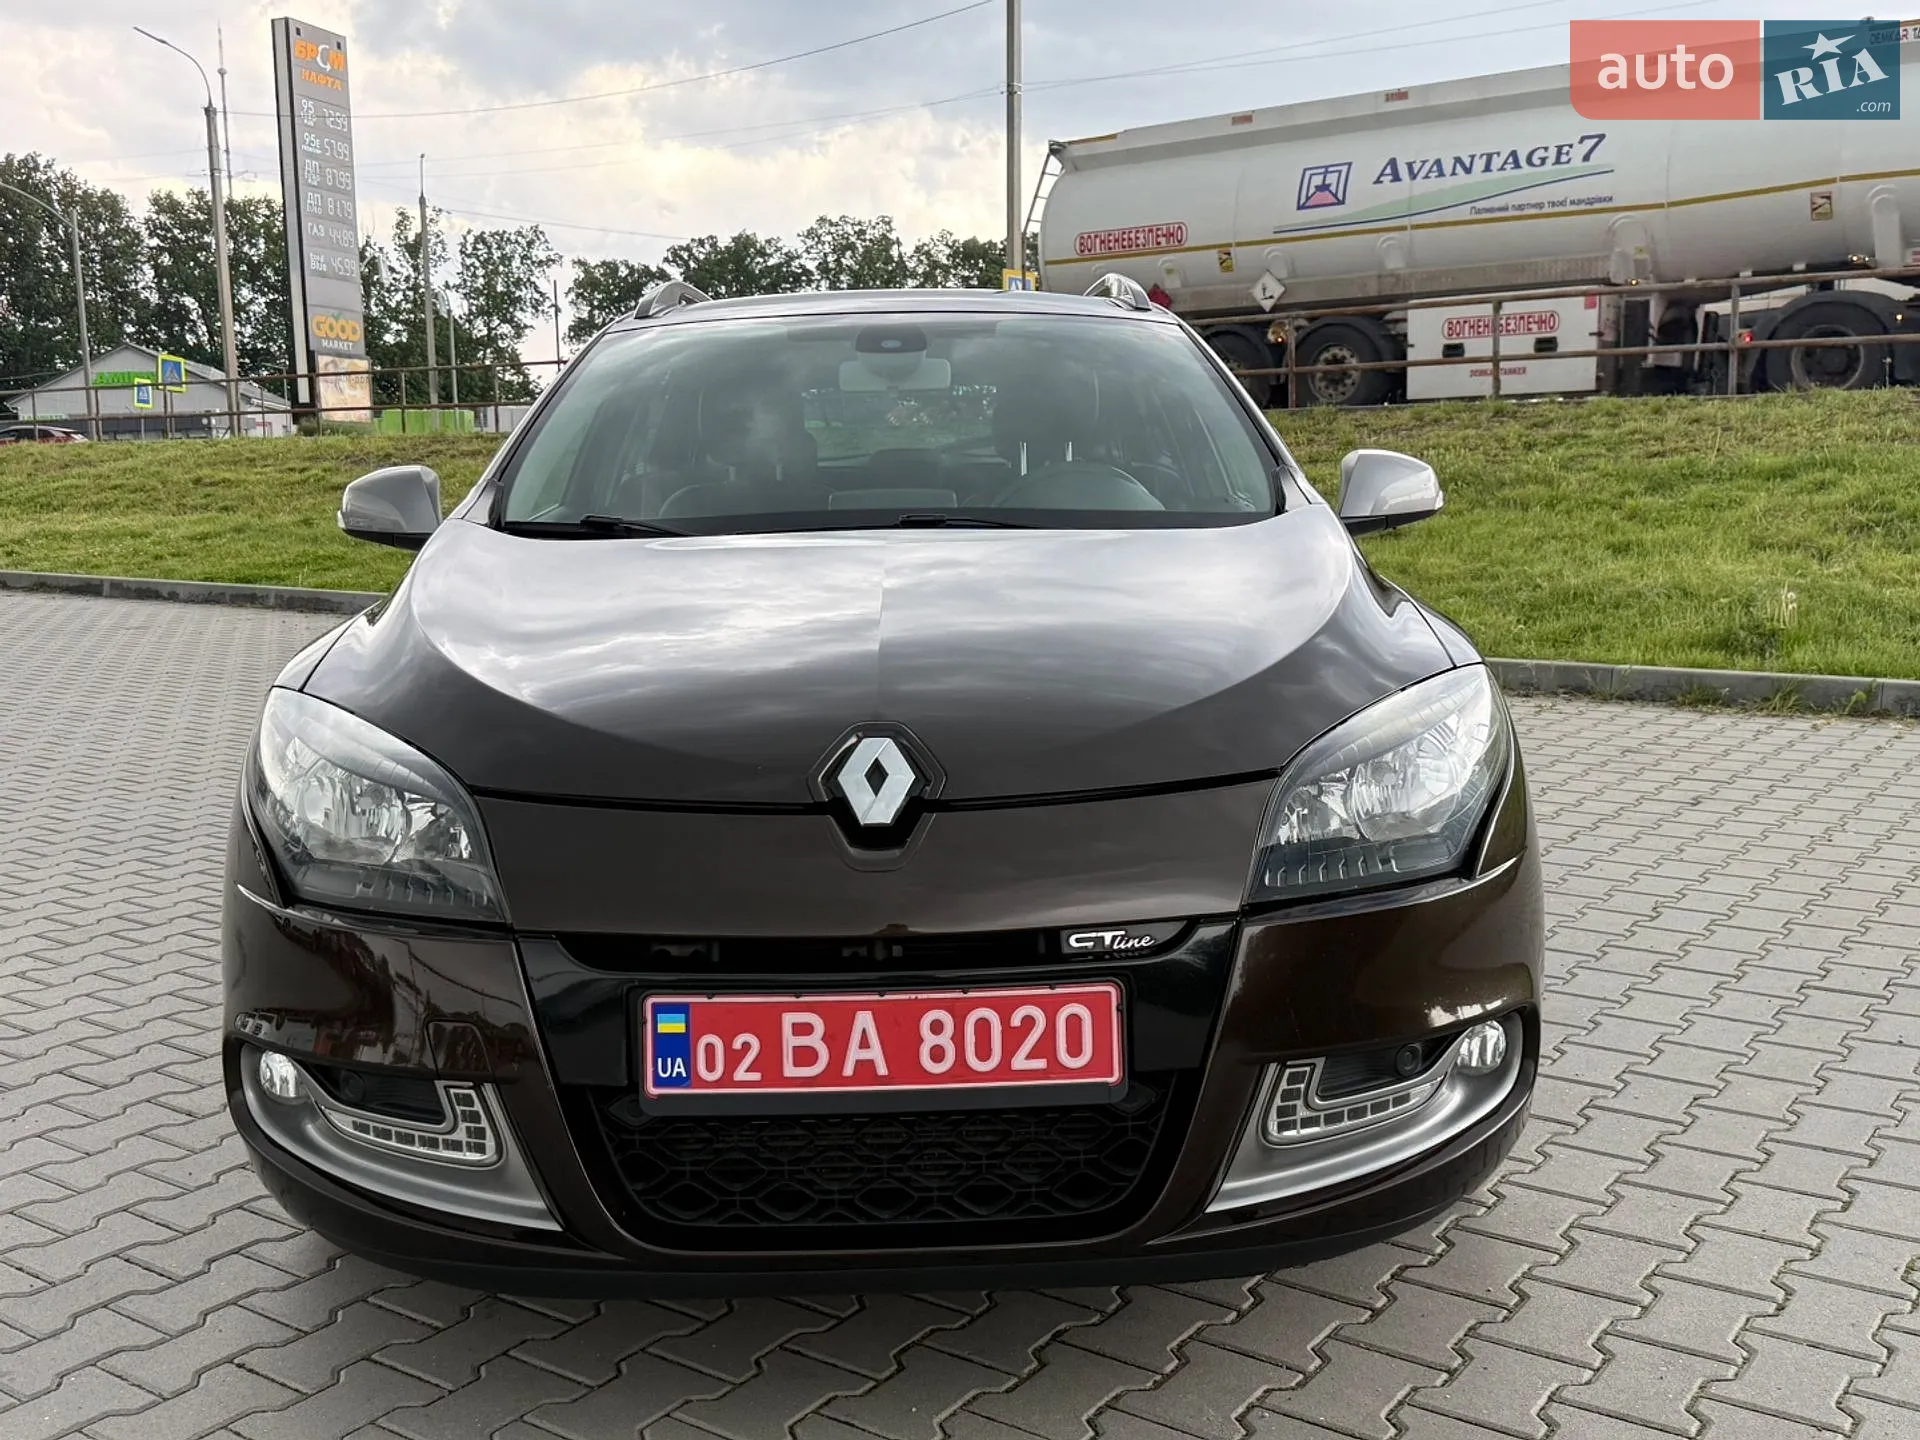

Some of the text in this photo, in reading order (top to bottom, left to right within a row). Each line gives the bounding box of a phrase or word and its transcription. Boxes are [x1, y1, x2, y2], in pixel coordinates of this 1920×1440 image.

[301, 68, 343, 91] НАФТА
[301, 99, 314, 114] 95
[1372, 133, 1606, 185] AVANTAGE7
[1511, 200, 1545, 212] партнер
[1079, 225, 1183, 253] ВОГНЕНЕБЕЗПЕЧНО
[312, 314, 360, 343] GOOD
[321, 339, 353, 351] MARKET
[696, 1002, 1093, 1082] 02 BA 8020
[657, 1057, 687, 1078] UA
